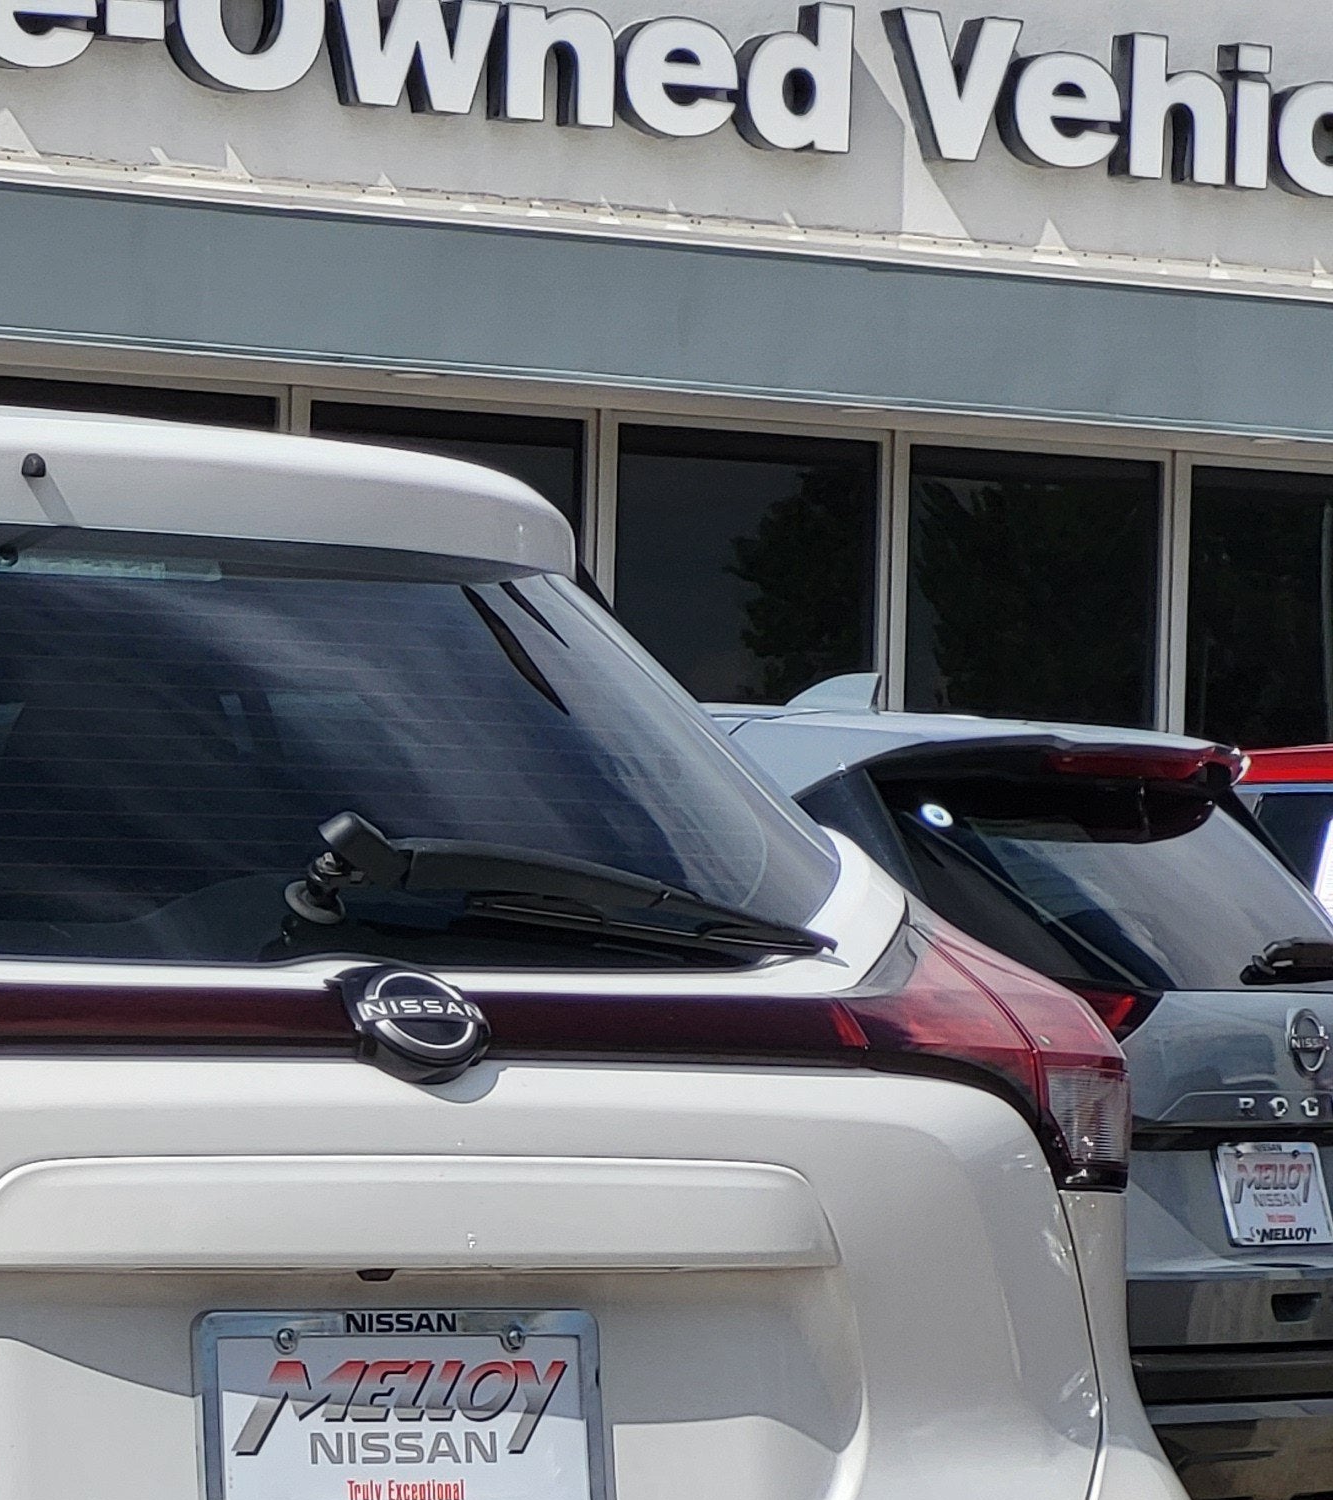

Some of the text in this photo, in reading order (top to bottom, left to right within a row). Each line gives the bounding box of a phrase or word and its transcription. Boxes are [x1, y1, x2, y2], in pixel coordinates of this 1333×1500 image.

[362, 999, 483, 1020] NISSAN
[345, 1312, 458, 1333] NISSAN
[232, 1359, 568, 1456] MELLOY
[310, 1431, 498, 1465] NISSAN
